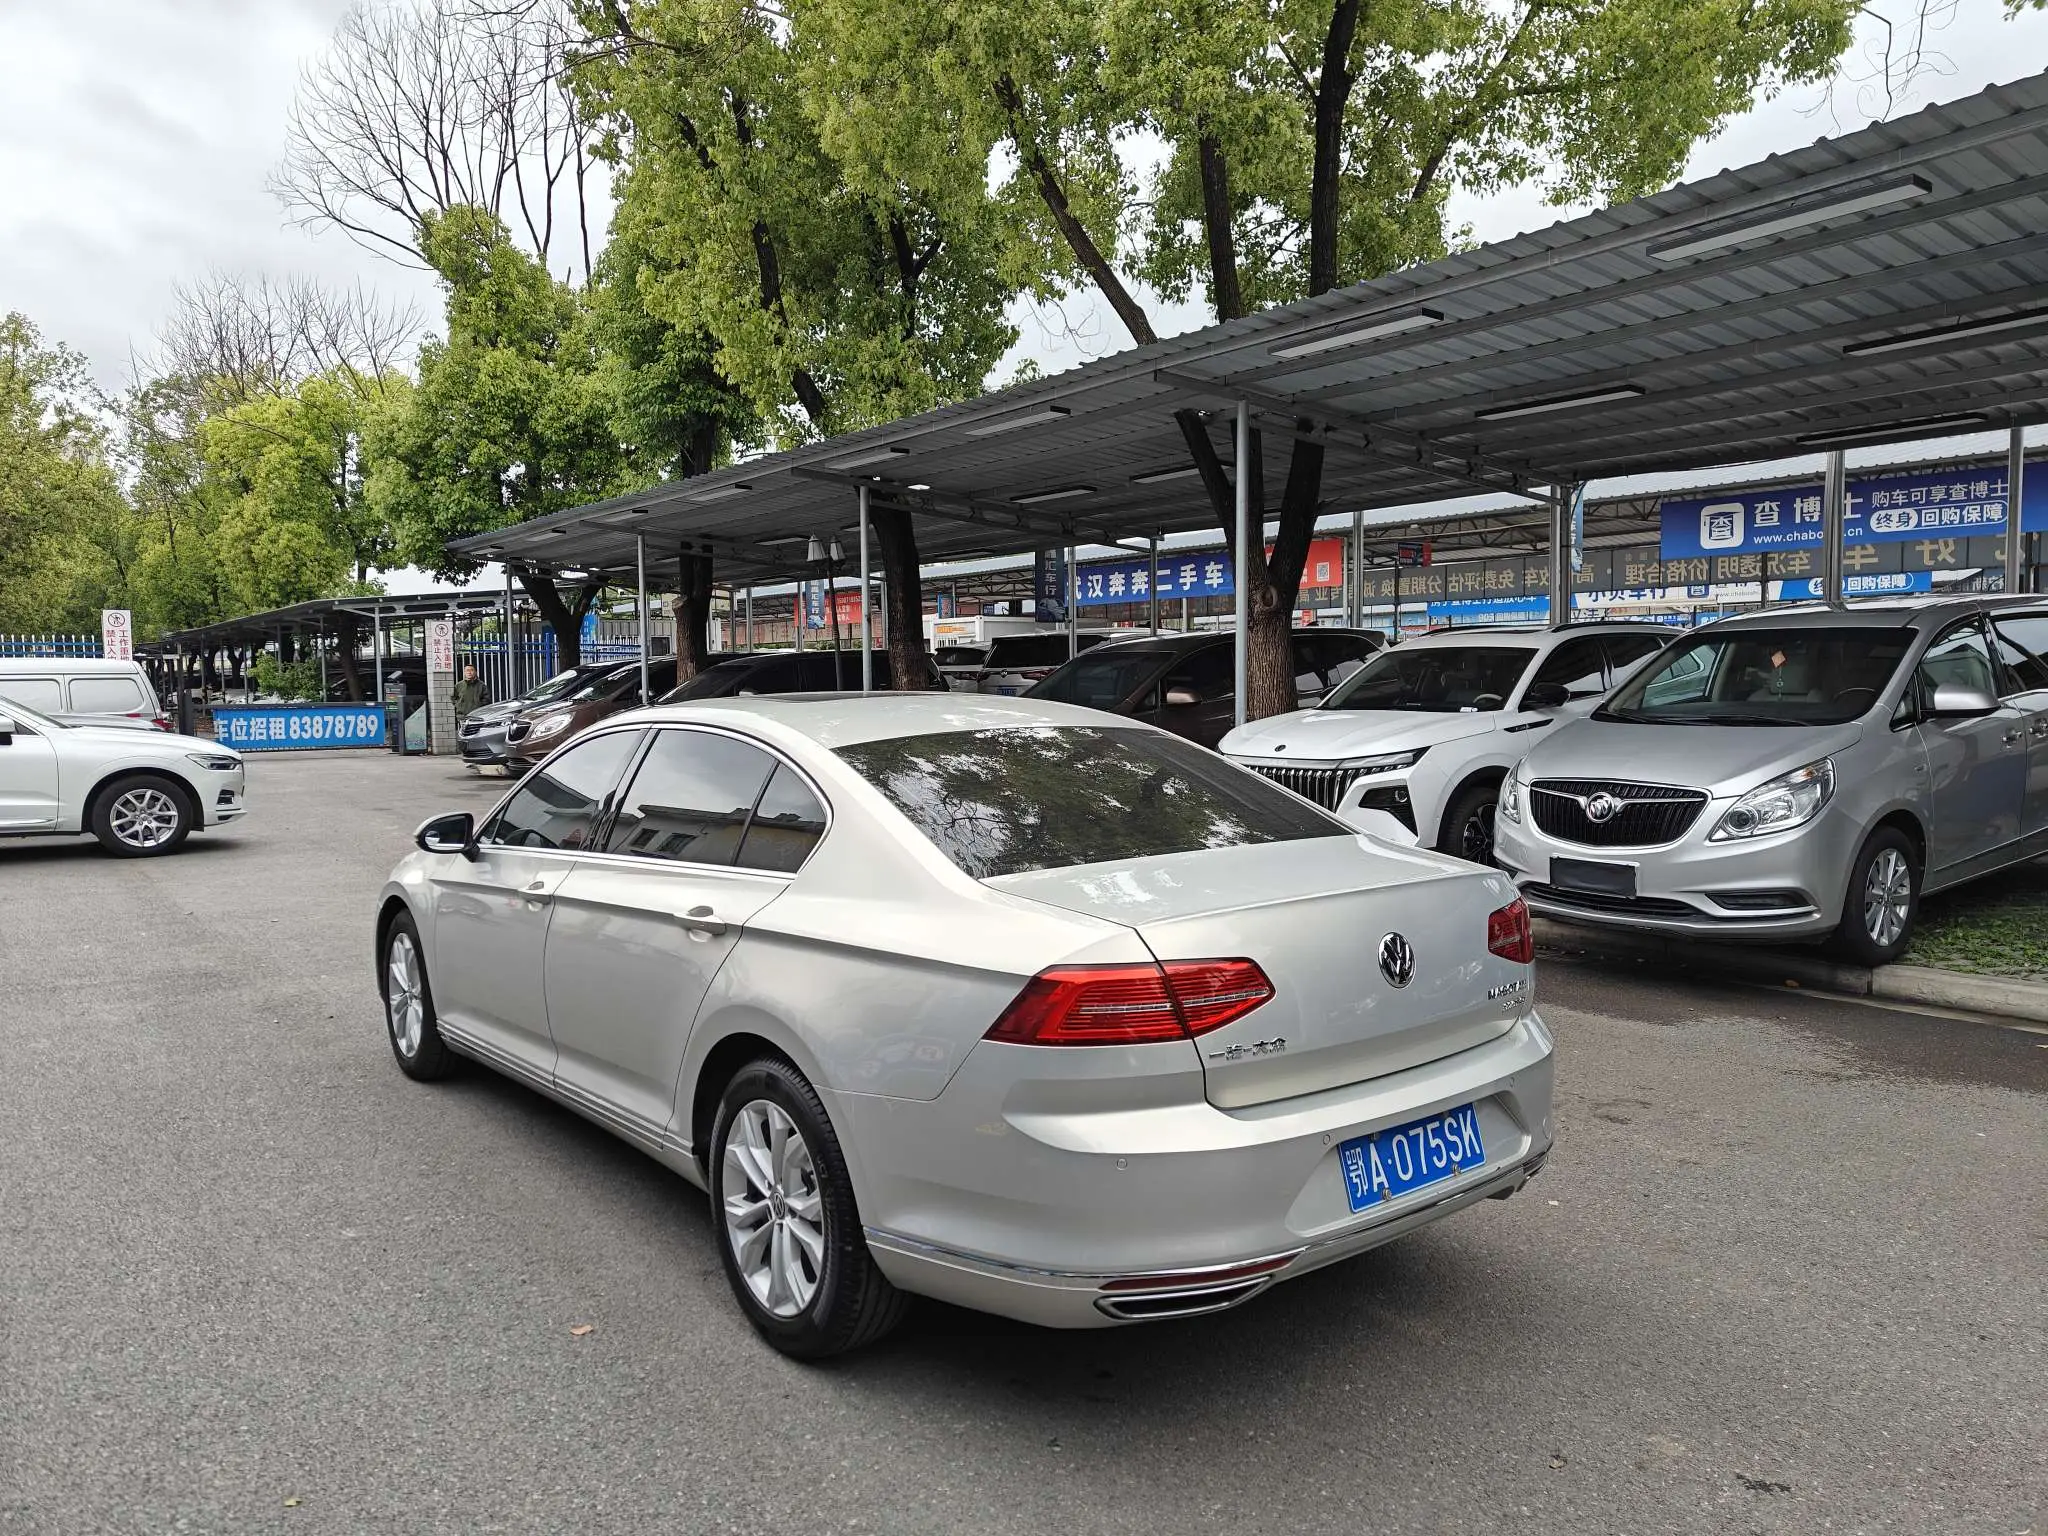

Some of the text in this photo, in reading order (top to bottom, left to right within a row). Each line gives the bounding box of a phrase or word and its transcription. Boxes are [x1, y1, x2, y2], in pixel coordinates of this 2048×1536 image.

[1872, 479, 2008, 508] 购车可享查博士
[1754, 492, 1863, 527] 查博士
[213, 714, 379, 742] 车位招租 83878789
